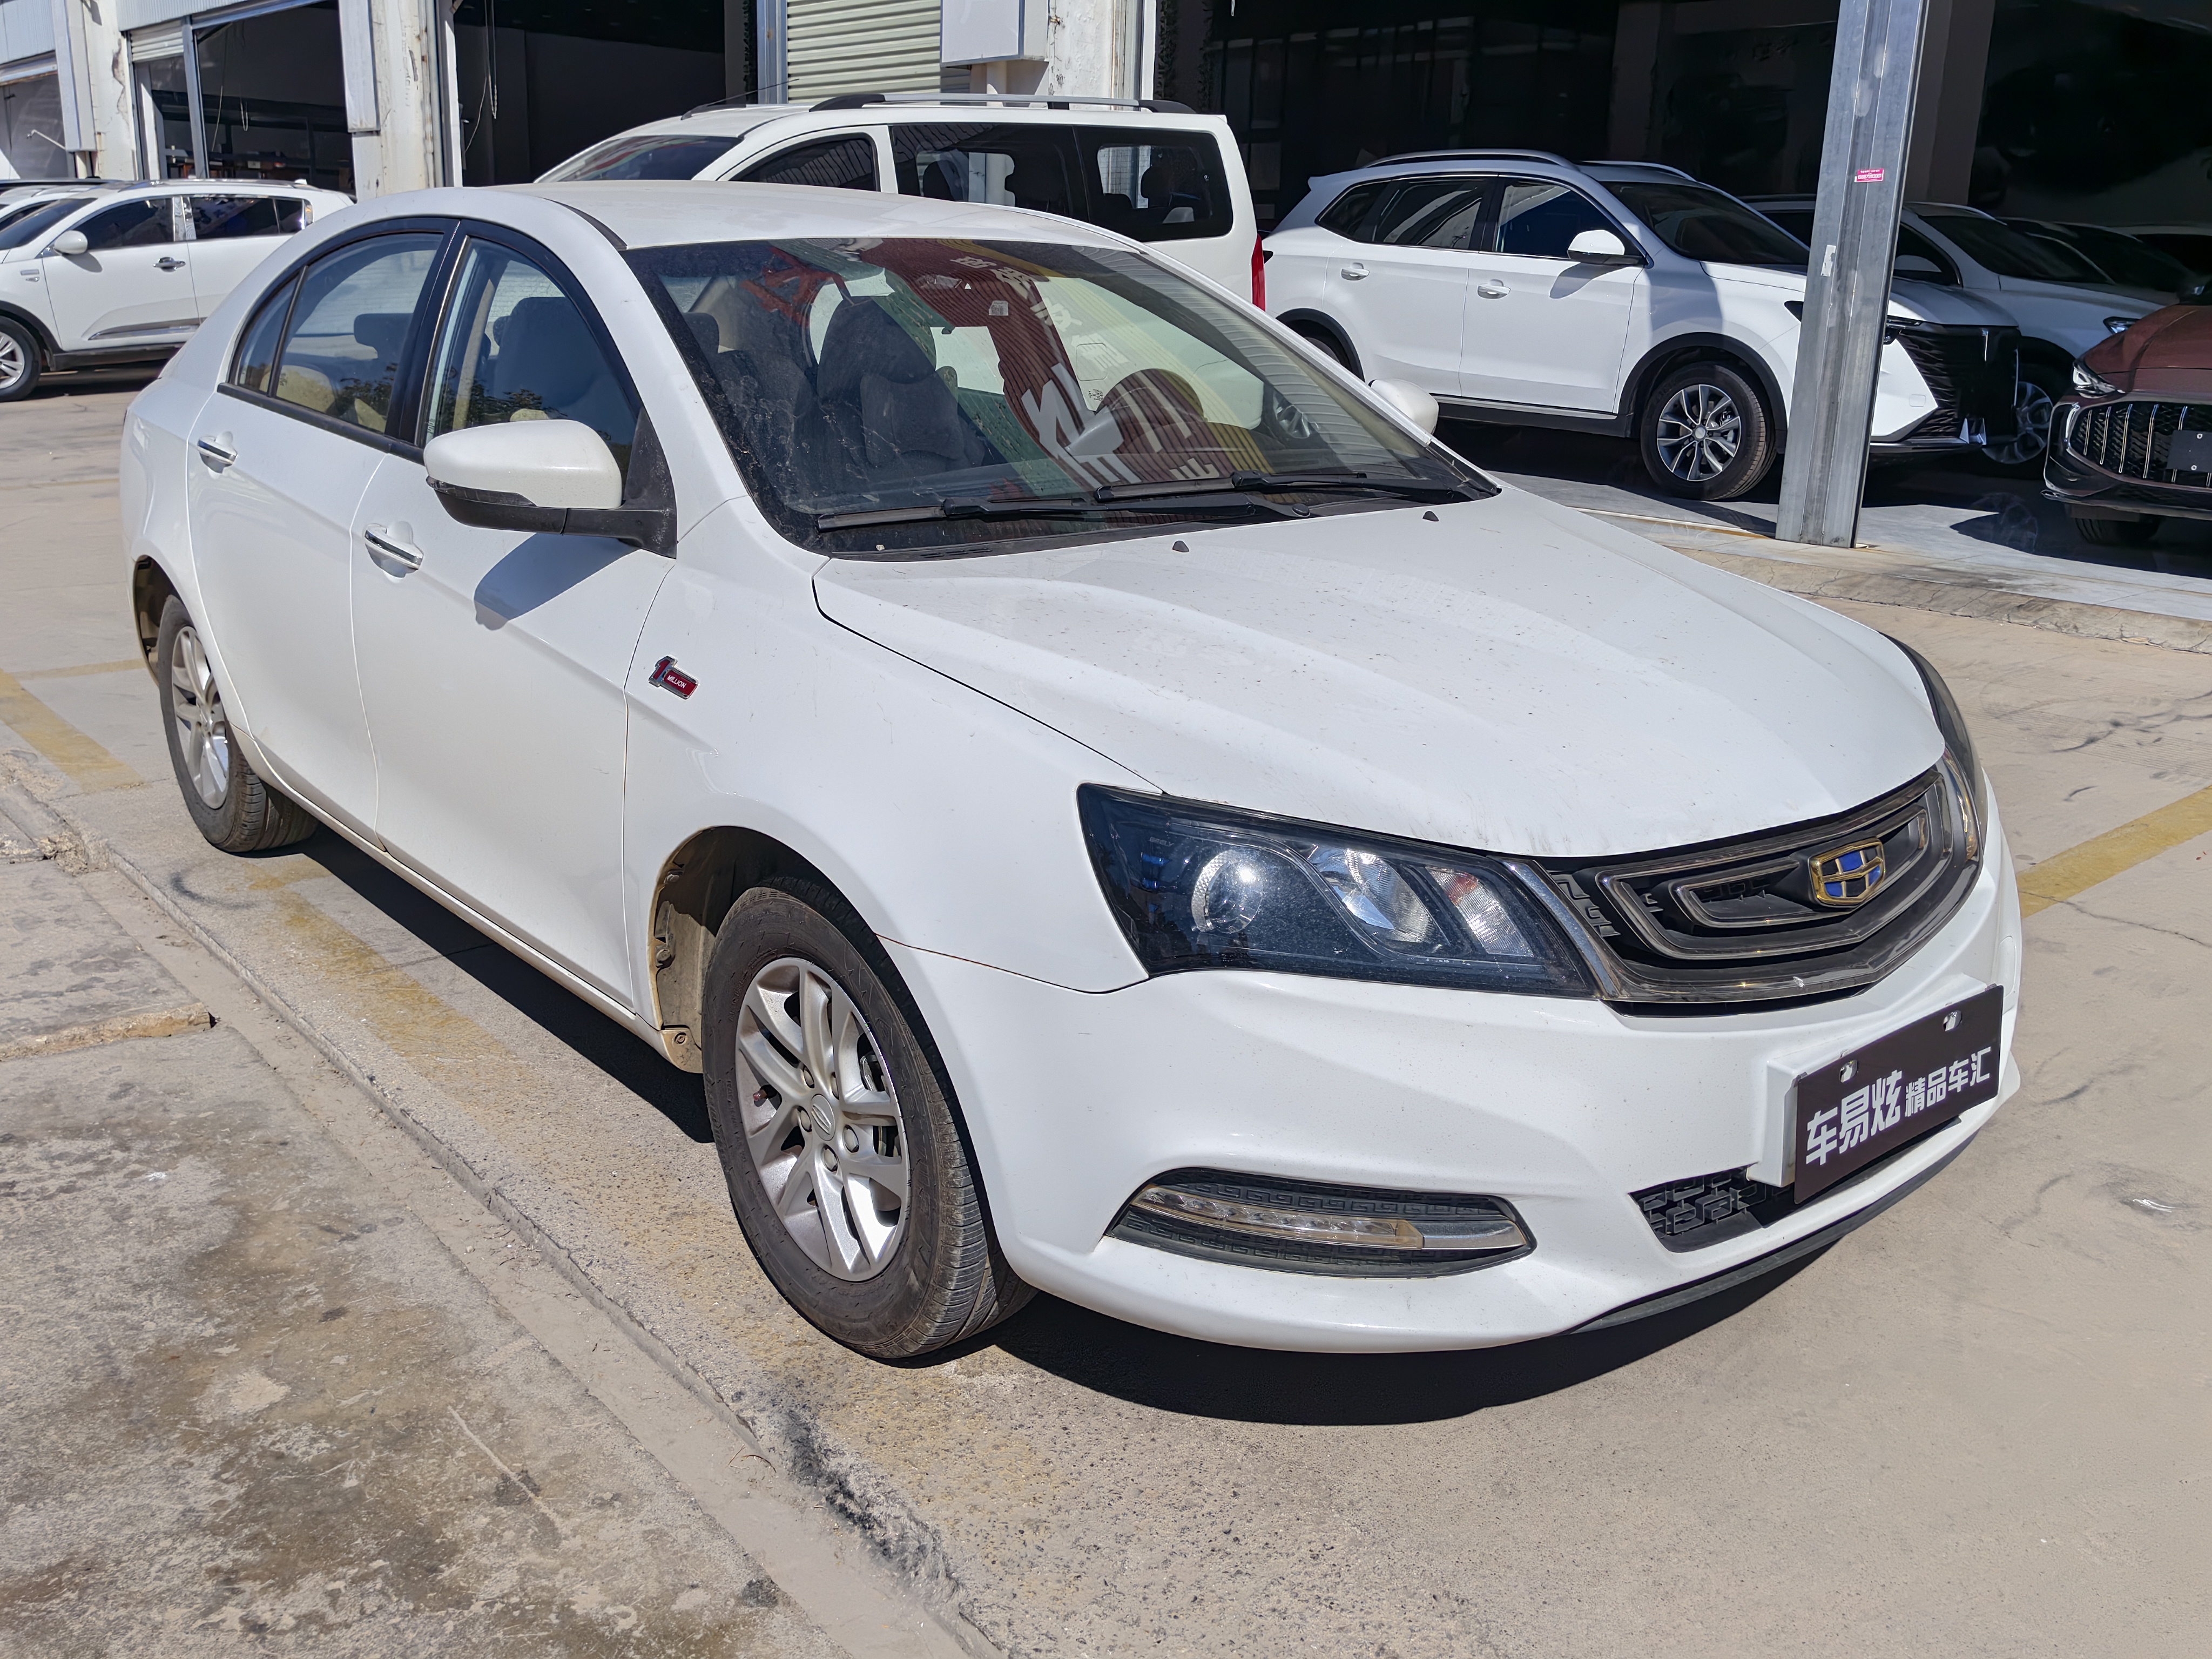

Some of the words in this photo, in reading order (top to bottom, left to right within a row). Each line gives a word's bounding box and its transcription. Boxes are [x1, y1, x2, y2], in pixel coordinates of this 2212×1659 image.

[666, 675, 687, 689] MILLION
[1806, 1069, 1903, 1165] 车易炫
[1904, 1046, 1992, 1117] 精品车汇
